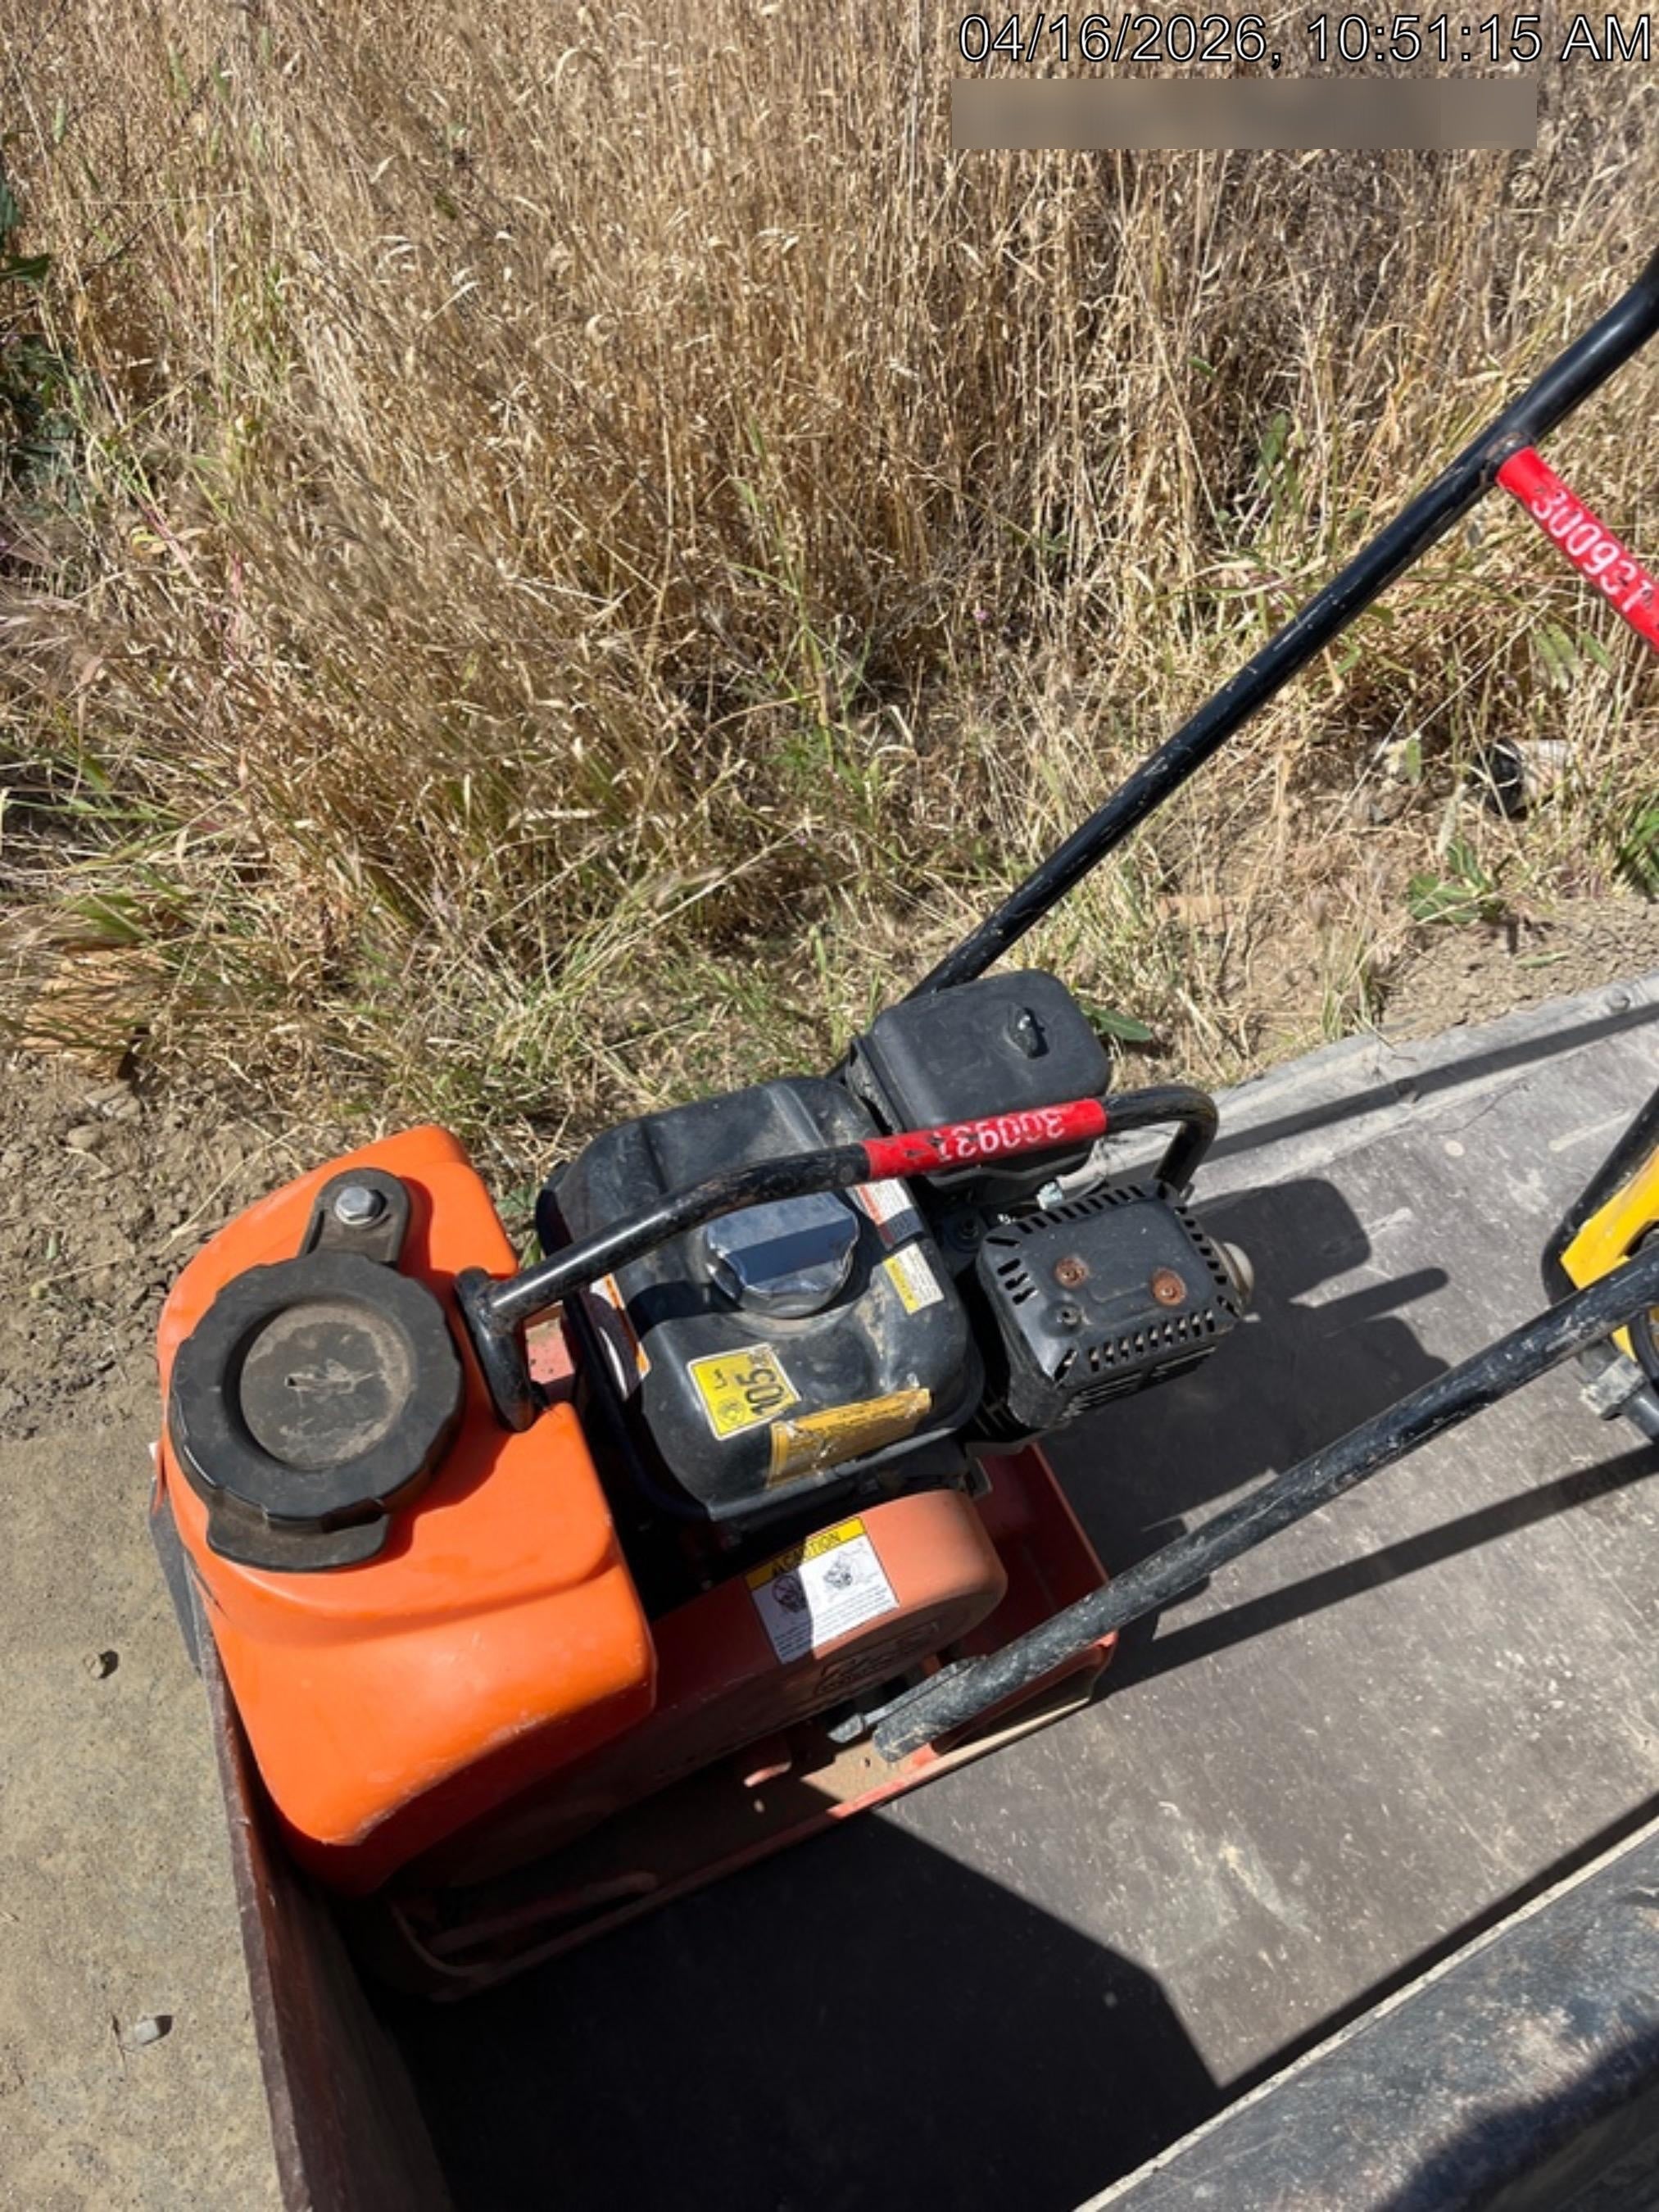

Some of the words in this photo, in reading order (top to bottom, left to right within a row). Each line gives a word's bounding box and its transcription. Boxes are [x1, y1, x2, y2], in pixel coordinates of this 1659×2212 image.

[1531, 488, 1654, 613] 300931
[932, 1108, 1065, 1163] 300931
[735, 1367, 786, 1416] 105
